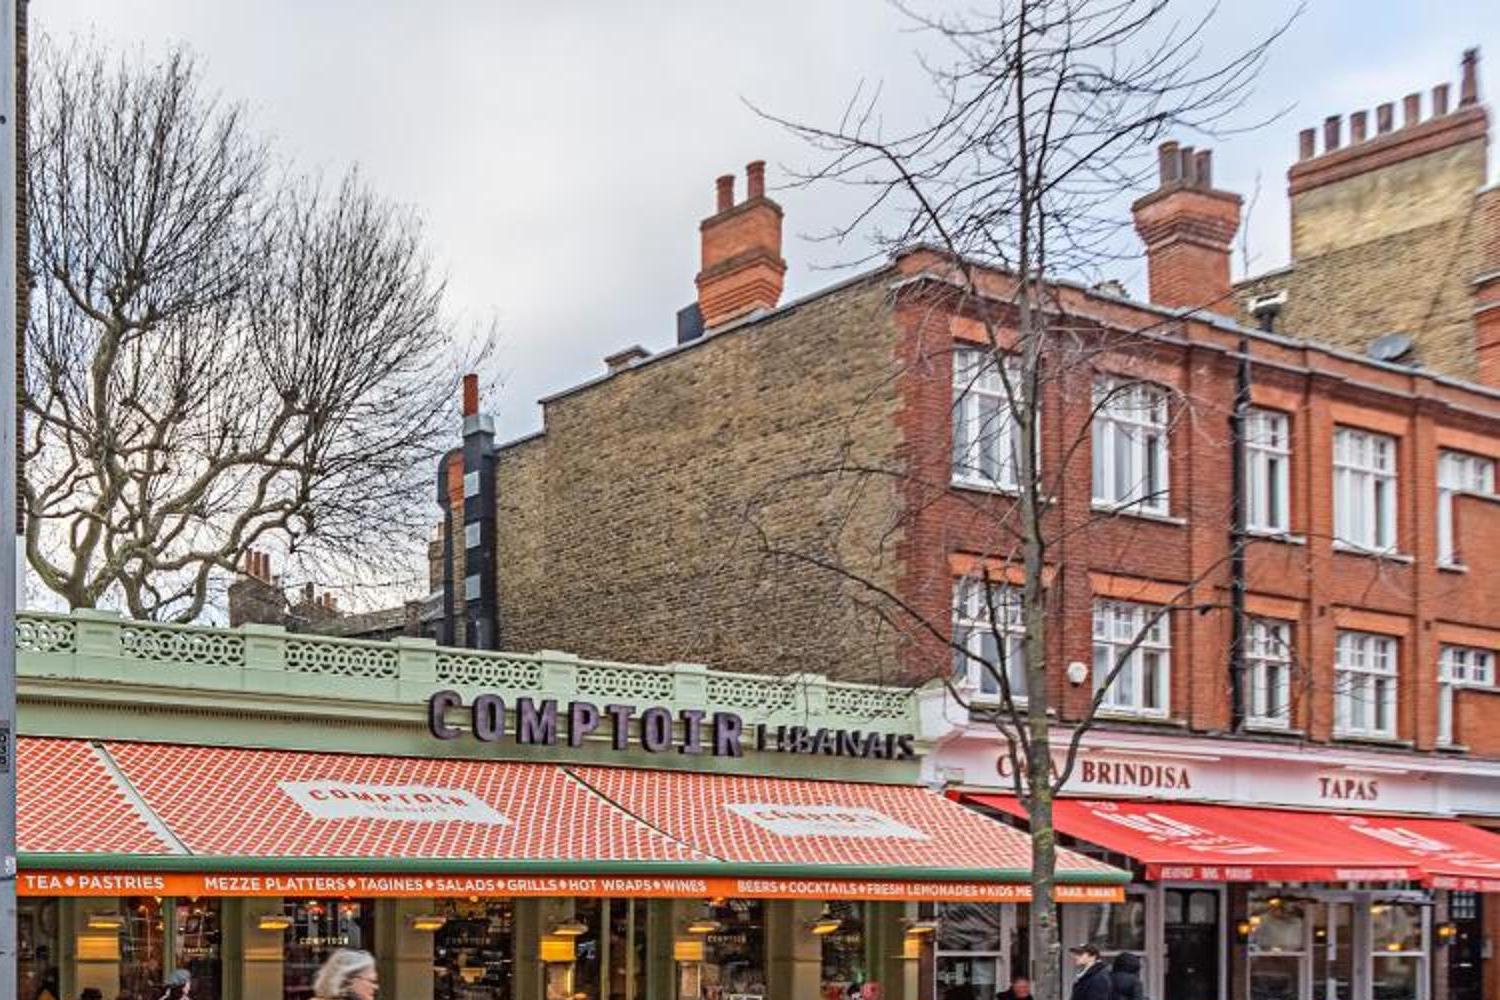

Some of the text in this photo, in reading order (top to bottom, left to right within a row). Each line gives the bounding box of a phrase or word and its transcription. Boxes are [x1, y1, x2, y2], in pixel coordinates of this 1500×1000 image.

[428, 690, 916, 762] COMPTOIR LIBANAIS
[1080, 759, 1192, 790] BRINDISA
[1318, 777, 1380, 801] TAPAS
[26, 875, 62, 890] TEA
[78, 875, 165, 890] PASTRIES
[204, 876, 261, 891] MEZZE
[265, 877, 345, 892] PLATTERS
[358, 877, 424, 892] TAGINES
[435, 878, 495, 893] SALADS
[506, 879, 558, 893] GRILLS
[568, 879, 597, 893] HOT
[601, 879, 652, 894] WRAPS
[662, 880, 707, 894] WINES
[737, 880, 780, 894] BEERS
[788, 881, 859, 896] COCKTAILS
[865, 882, 905, 897] FRESH
[906, 883, 980, 897] LEMONADES
[986, 885, 1013, 898] KIDS
